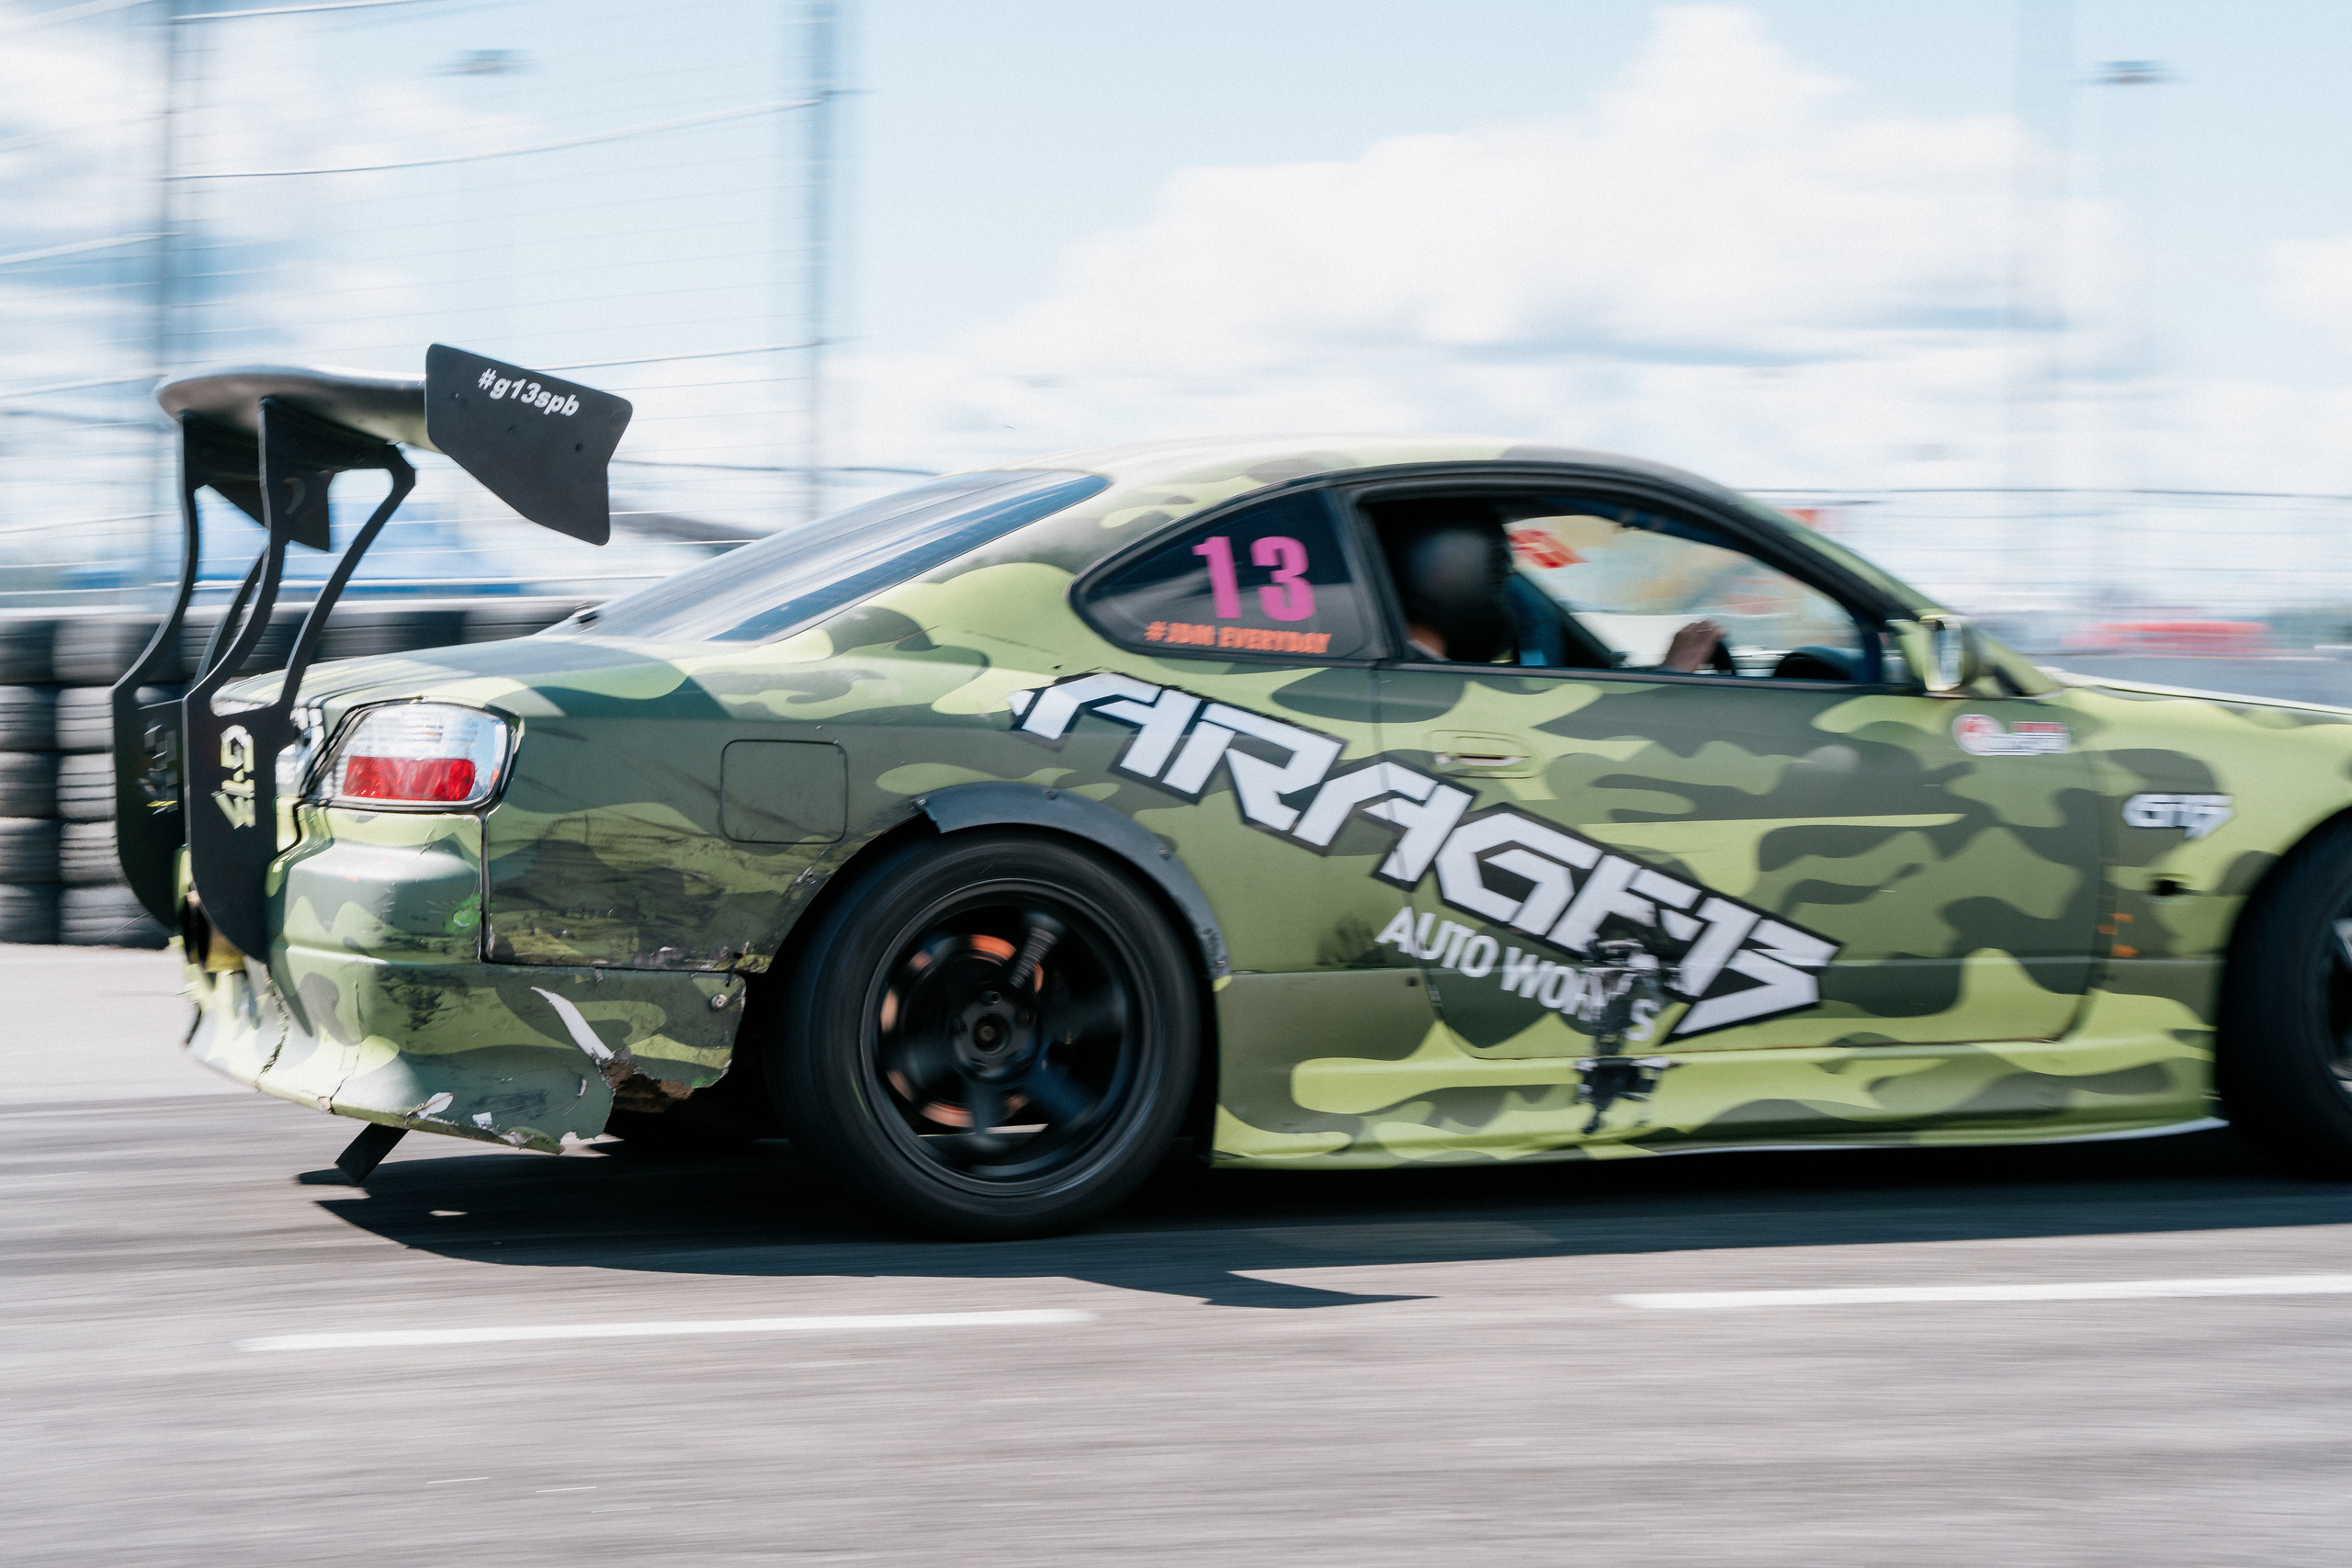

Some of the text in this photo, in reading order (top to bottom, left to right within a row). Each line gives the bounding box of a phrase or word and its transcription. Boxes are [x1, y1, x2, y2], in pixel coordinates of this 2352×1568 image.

[478, 367, 581, 417] #g13spb
[1193, 536, 1316, 622] 13
[1374, 906, 1499, 978] AUTO
